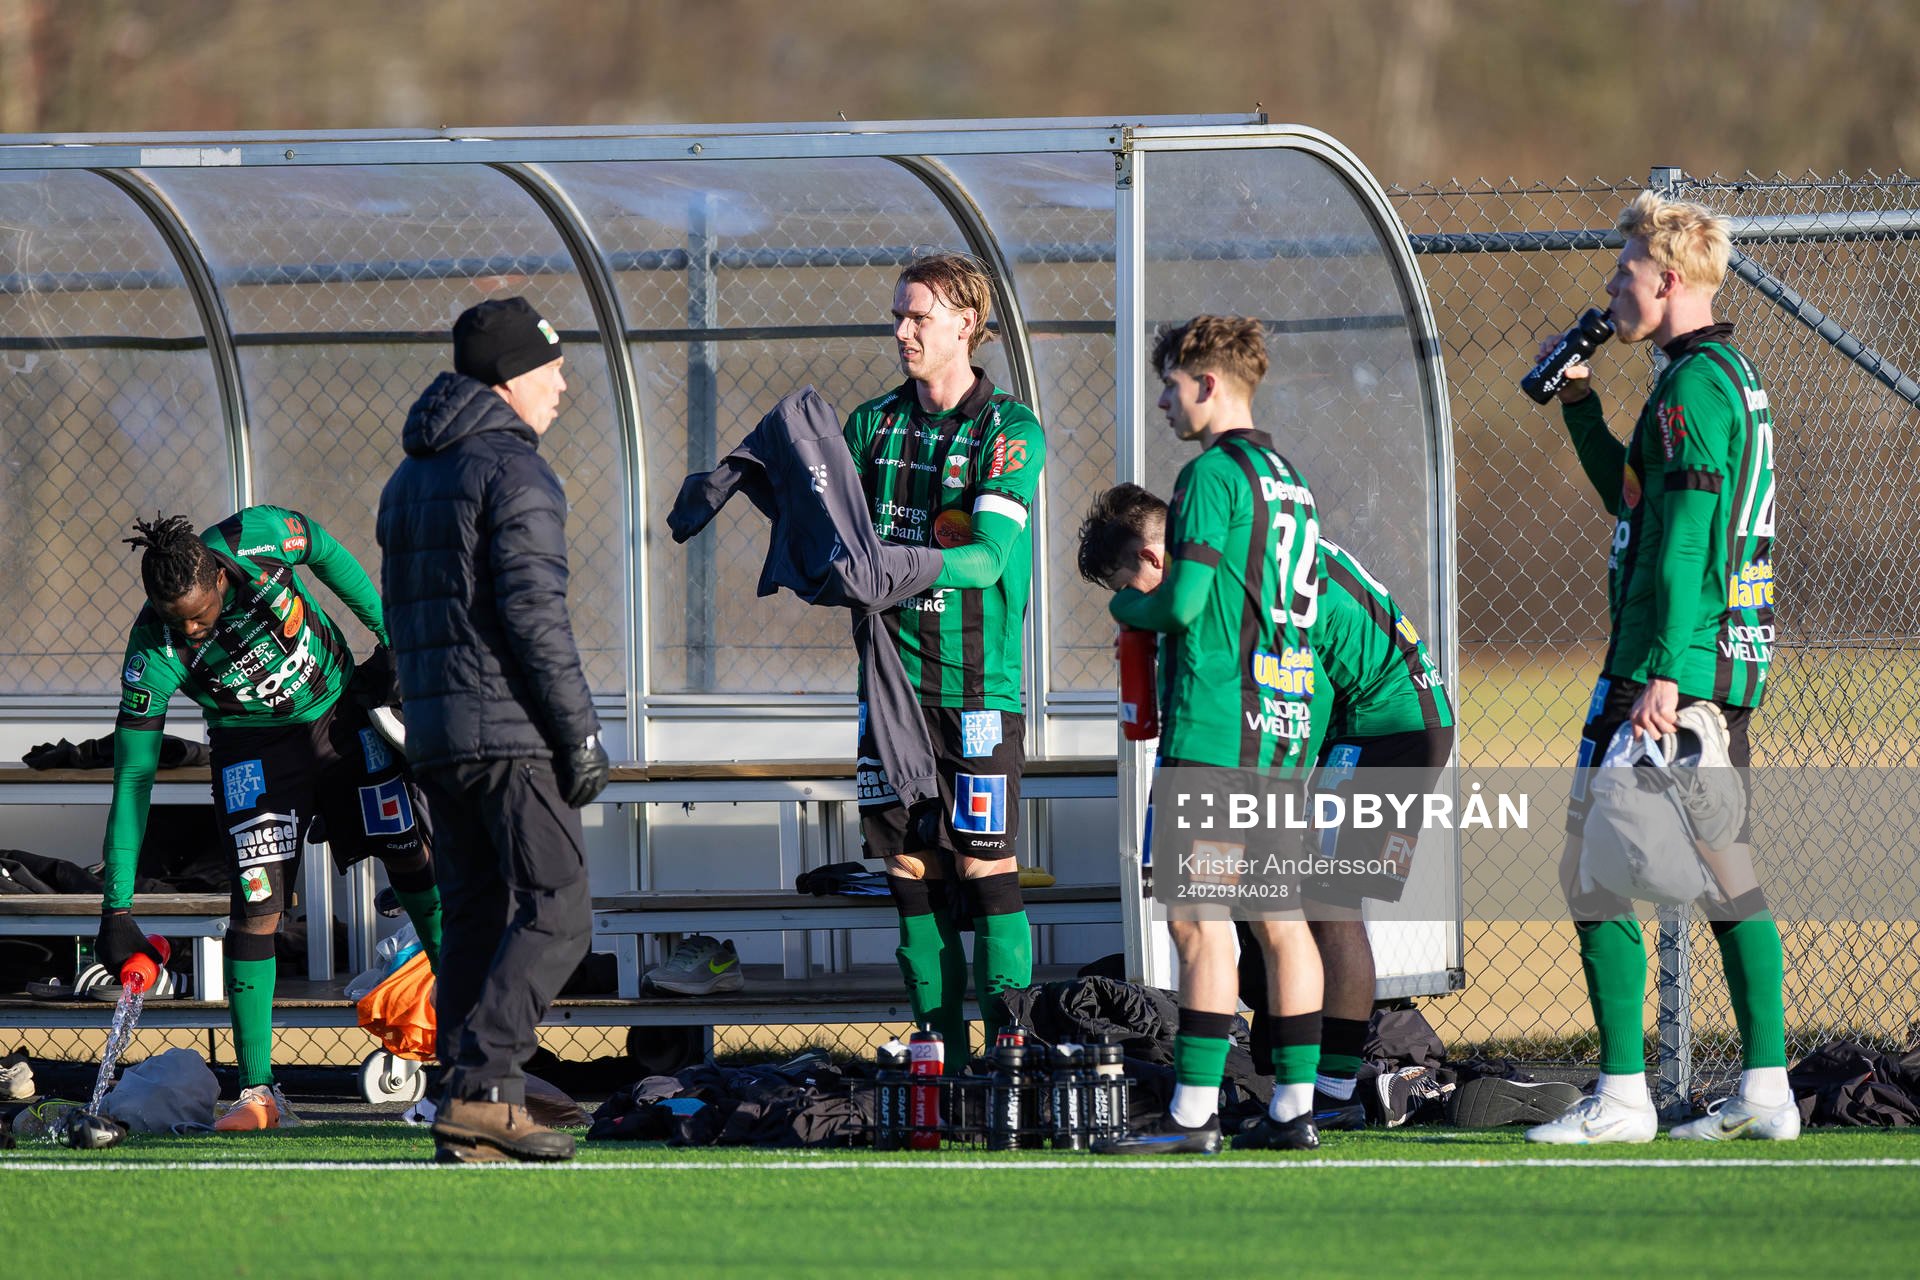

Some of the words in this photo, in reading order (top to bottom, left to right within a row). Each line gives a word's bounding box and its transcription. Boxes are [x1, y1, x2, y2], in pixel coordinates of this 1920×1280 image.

[1005, 439, 1028, 474] ICA
[875, 497, 928, 525] arbergs
[262, 654, 317, 708] VARBERG
[1253, 653, 1315, 695] Ullare
[965, 714, 995, 728] EFF
[966, 727, 999, 742] EKT
[225, 764, 256, 783] EFF
[227, 776, 263, 796] EKT
[971, 840, 1000, 848] CRAFT
[915, 1045, 932, 1059] 22
[881, 1086, 890, 1126] CRAFT
[897, 1086, 906, 1126] CRAFT
